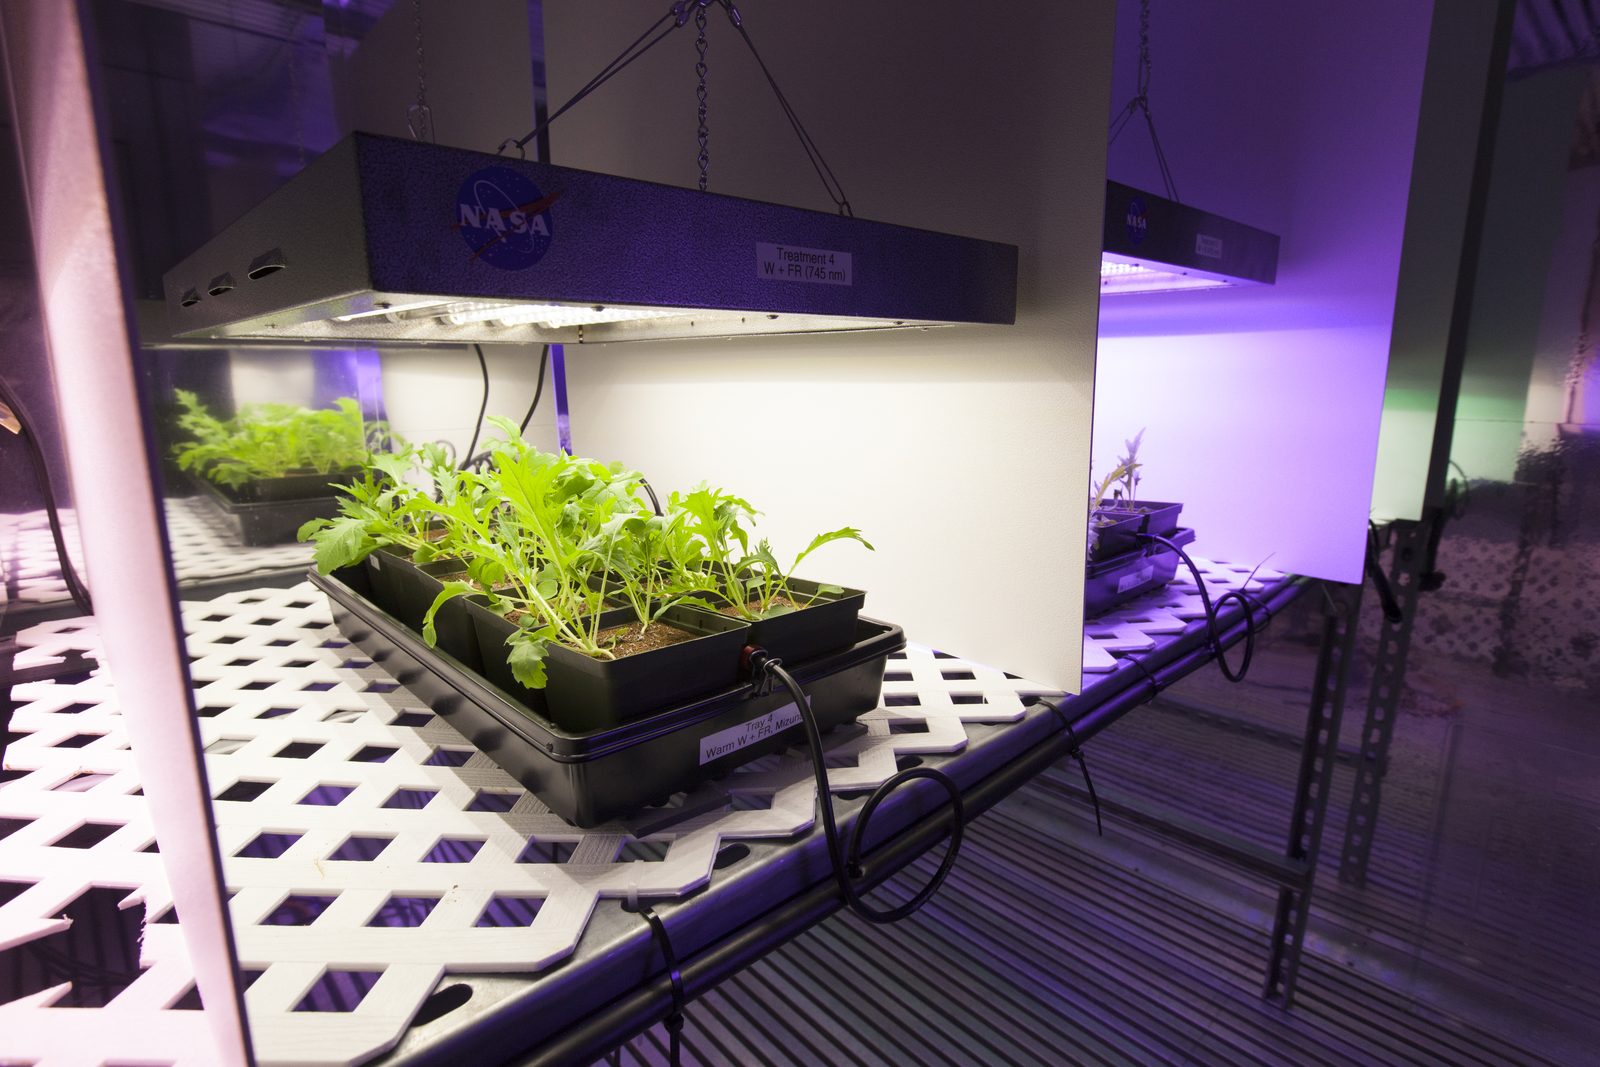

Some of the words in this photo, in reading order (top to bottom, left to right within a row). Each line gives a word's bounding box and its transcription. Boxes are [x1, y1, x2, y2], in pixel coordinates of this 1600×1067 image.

[460, 203, 550, 237] NASA
[1127, 213, 1146, 230] NASA
[776, 247, 826, 264] Treatment
[829, 254, 835, 265] 4
[764, 261, 775, 274] W
[778, 266, 784, 274] +
[788, 264, 802, 277] FR
[805, 265, 826, 280] (745
[829, 269, 846, 282] nm)
[746, 720, 765, 732] Tray
[768, 714, 773, 722] 4
[706, 742, 735, 758] Warm
[737, 735, 748, 746] W
[758, 726, 773, 738] FR,
[775, 714, 802, 730] Mizun
